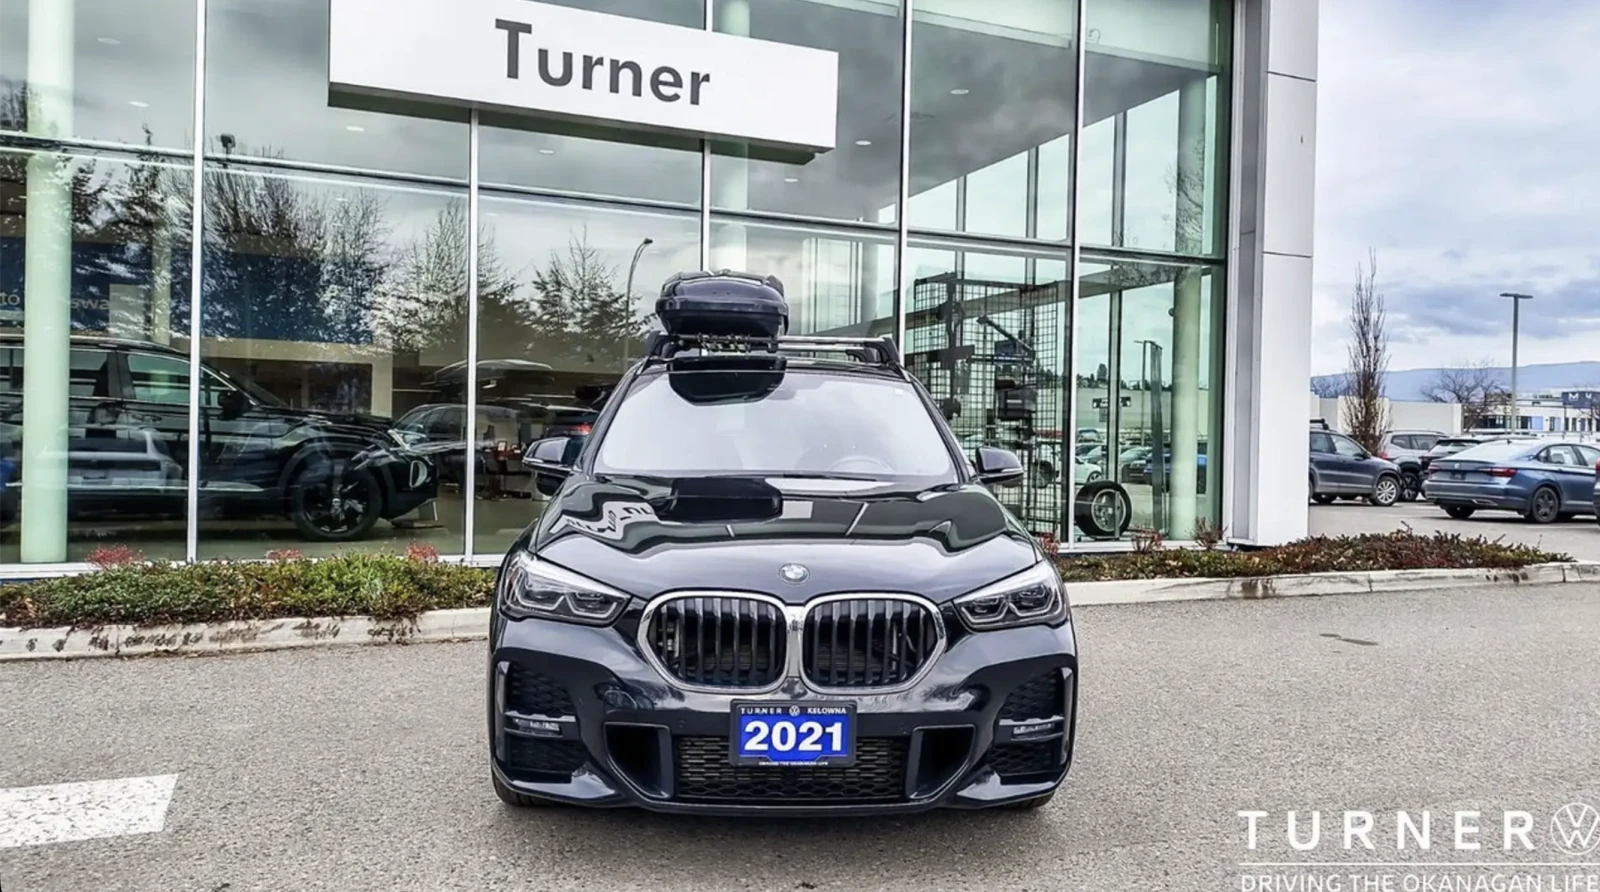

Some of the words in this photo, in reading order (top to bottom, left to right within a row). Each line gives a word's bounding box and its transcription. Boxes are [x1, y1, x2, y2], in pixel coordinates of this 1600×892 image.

[495, 18, 710, 106] Turner
[741, 707, 782, 715] TURNER
[807, 707, 847, 715] KELOWNA
[744, 720, 842, 752] 2021
